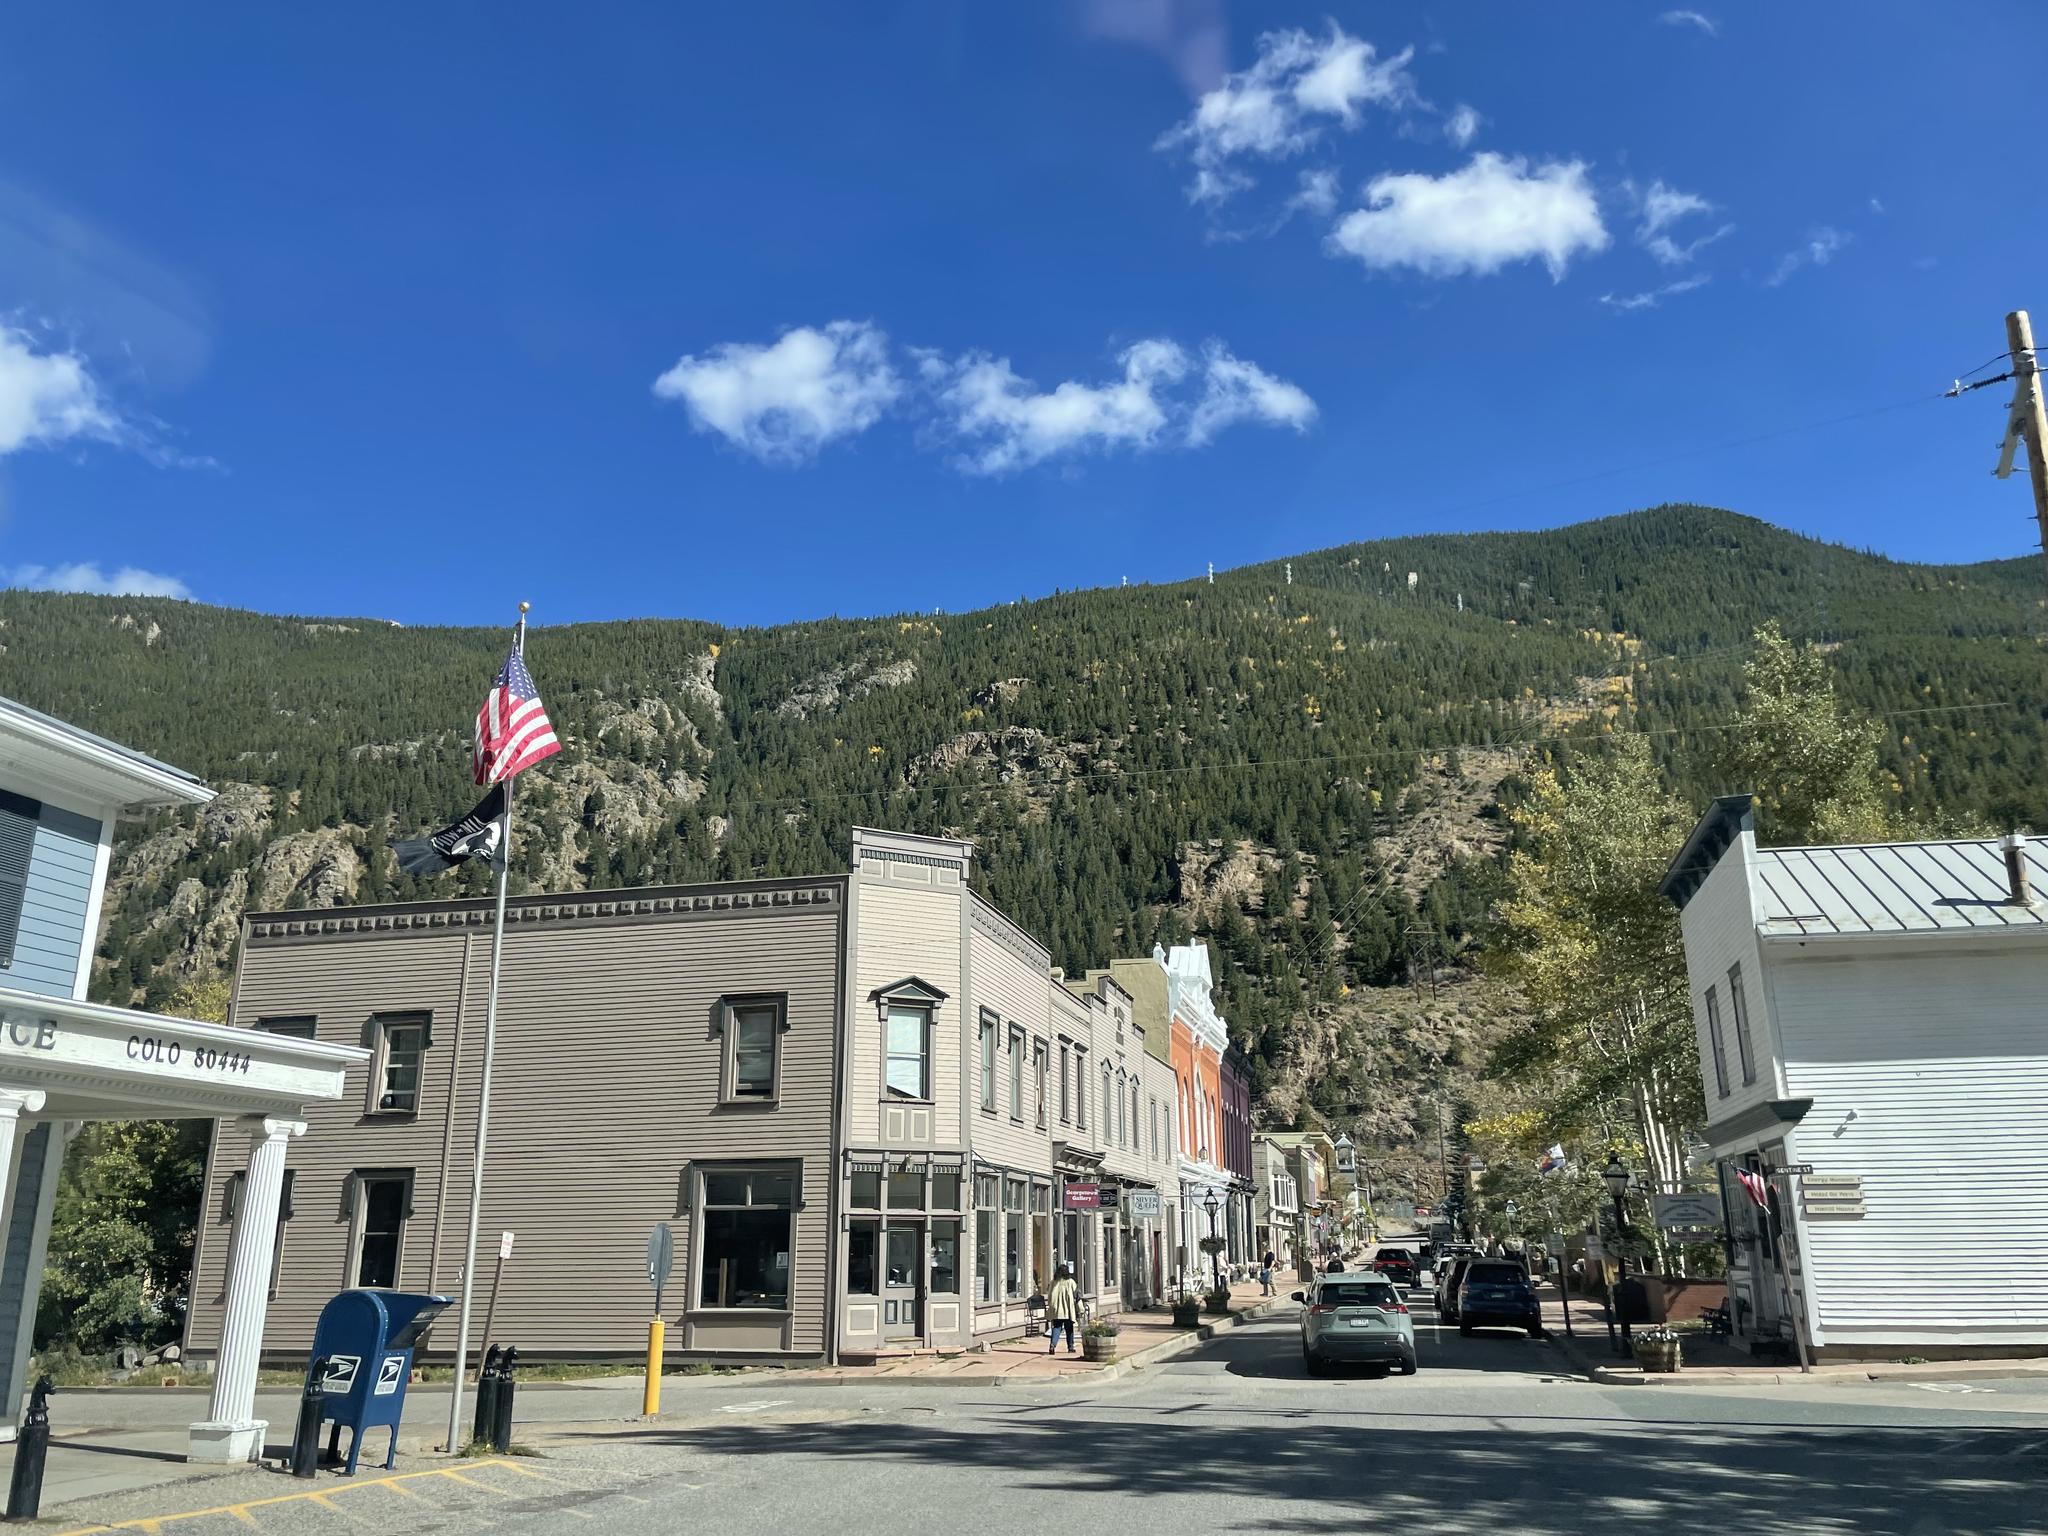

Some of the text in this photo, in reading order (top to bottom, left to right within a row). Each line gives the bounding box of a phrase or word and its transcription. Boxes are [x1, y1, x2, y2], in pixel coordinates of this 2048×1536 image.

[0, 1013, 251, 1075] CE COLO 80444
[1135, 1201, 1158, 1210] QUEEN
